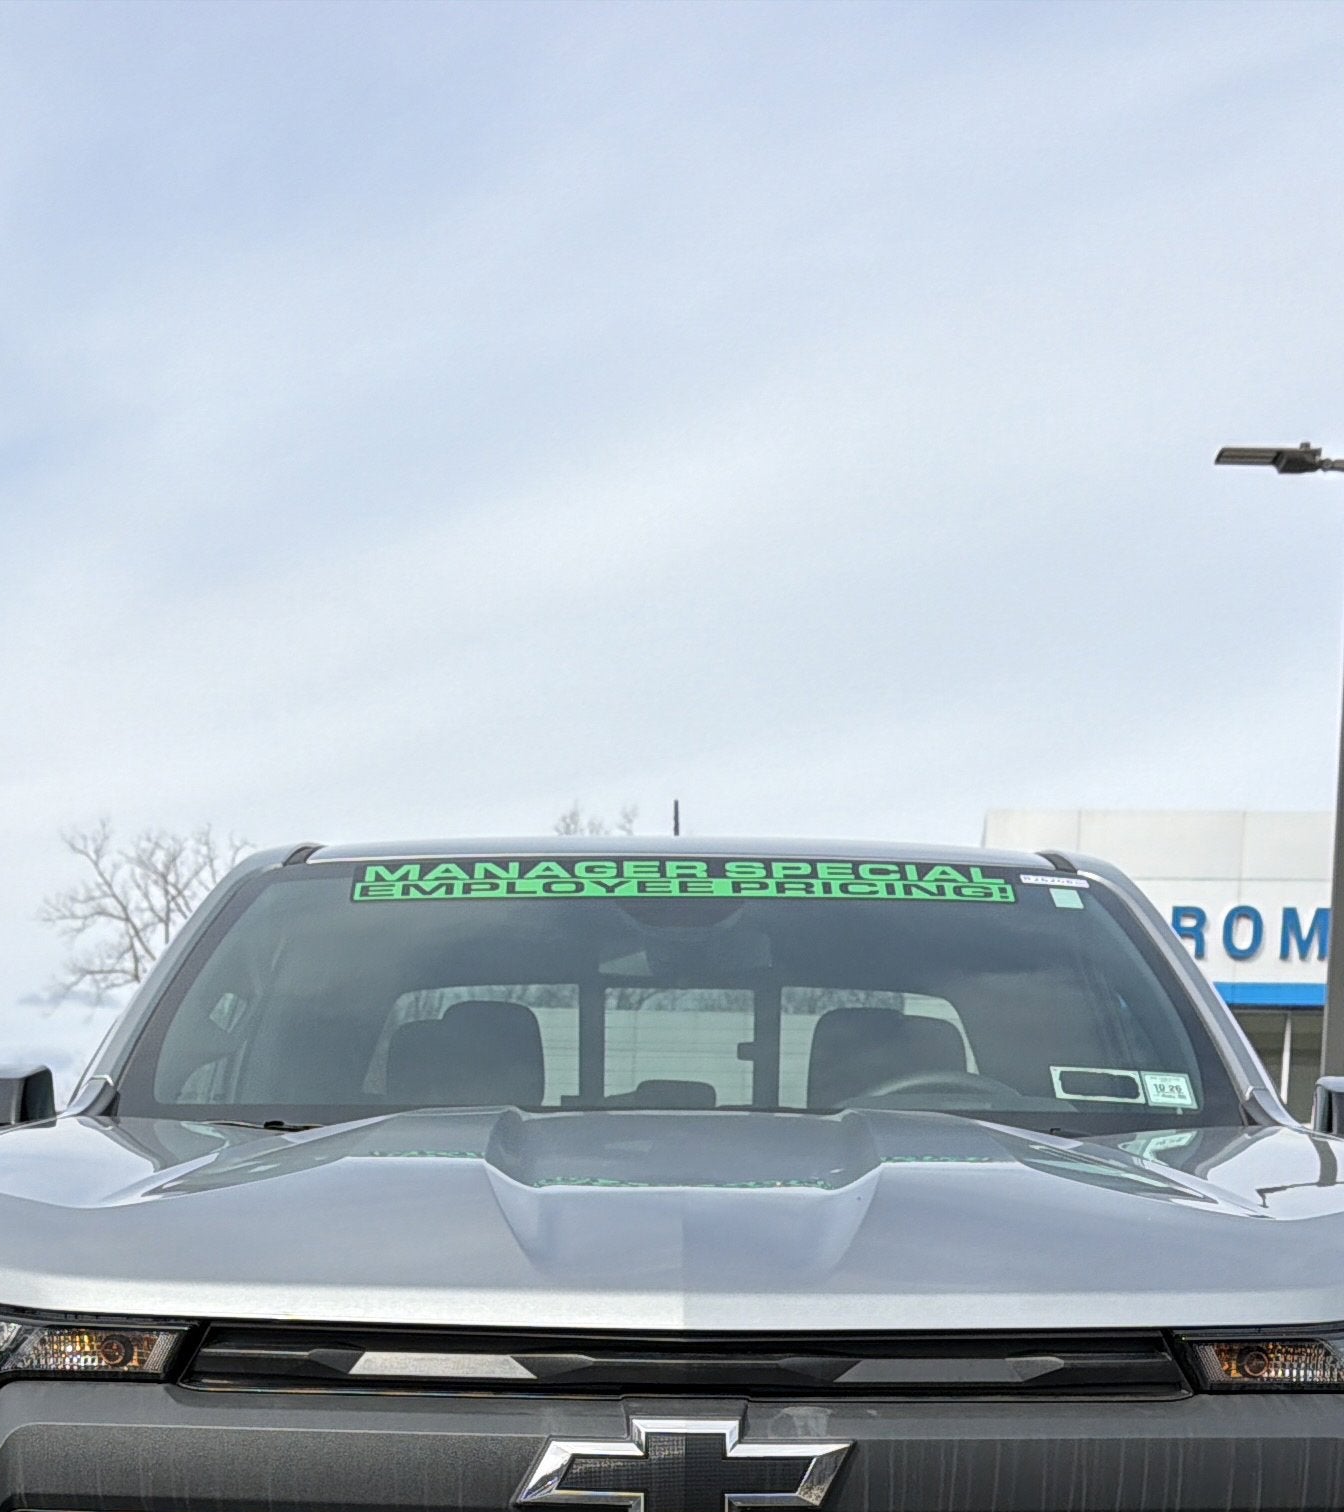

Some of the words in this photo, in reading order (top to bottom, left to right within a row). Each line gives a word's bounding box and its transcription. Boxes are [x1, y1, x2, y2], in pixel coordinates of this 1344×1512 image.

[364, 861, 708, 882] MANAGER
[725, 862, 1005, 884] SPECIAL
[359, 880, 714, 898] EMPLOYEE
[731, 880, 1011, 901] PRICING!
